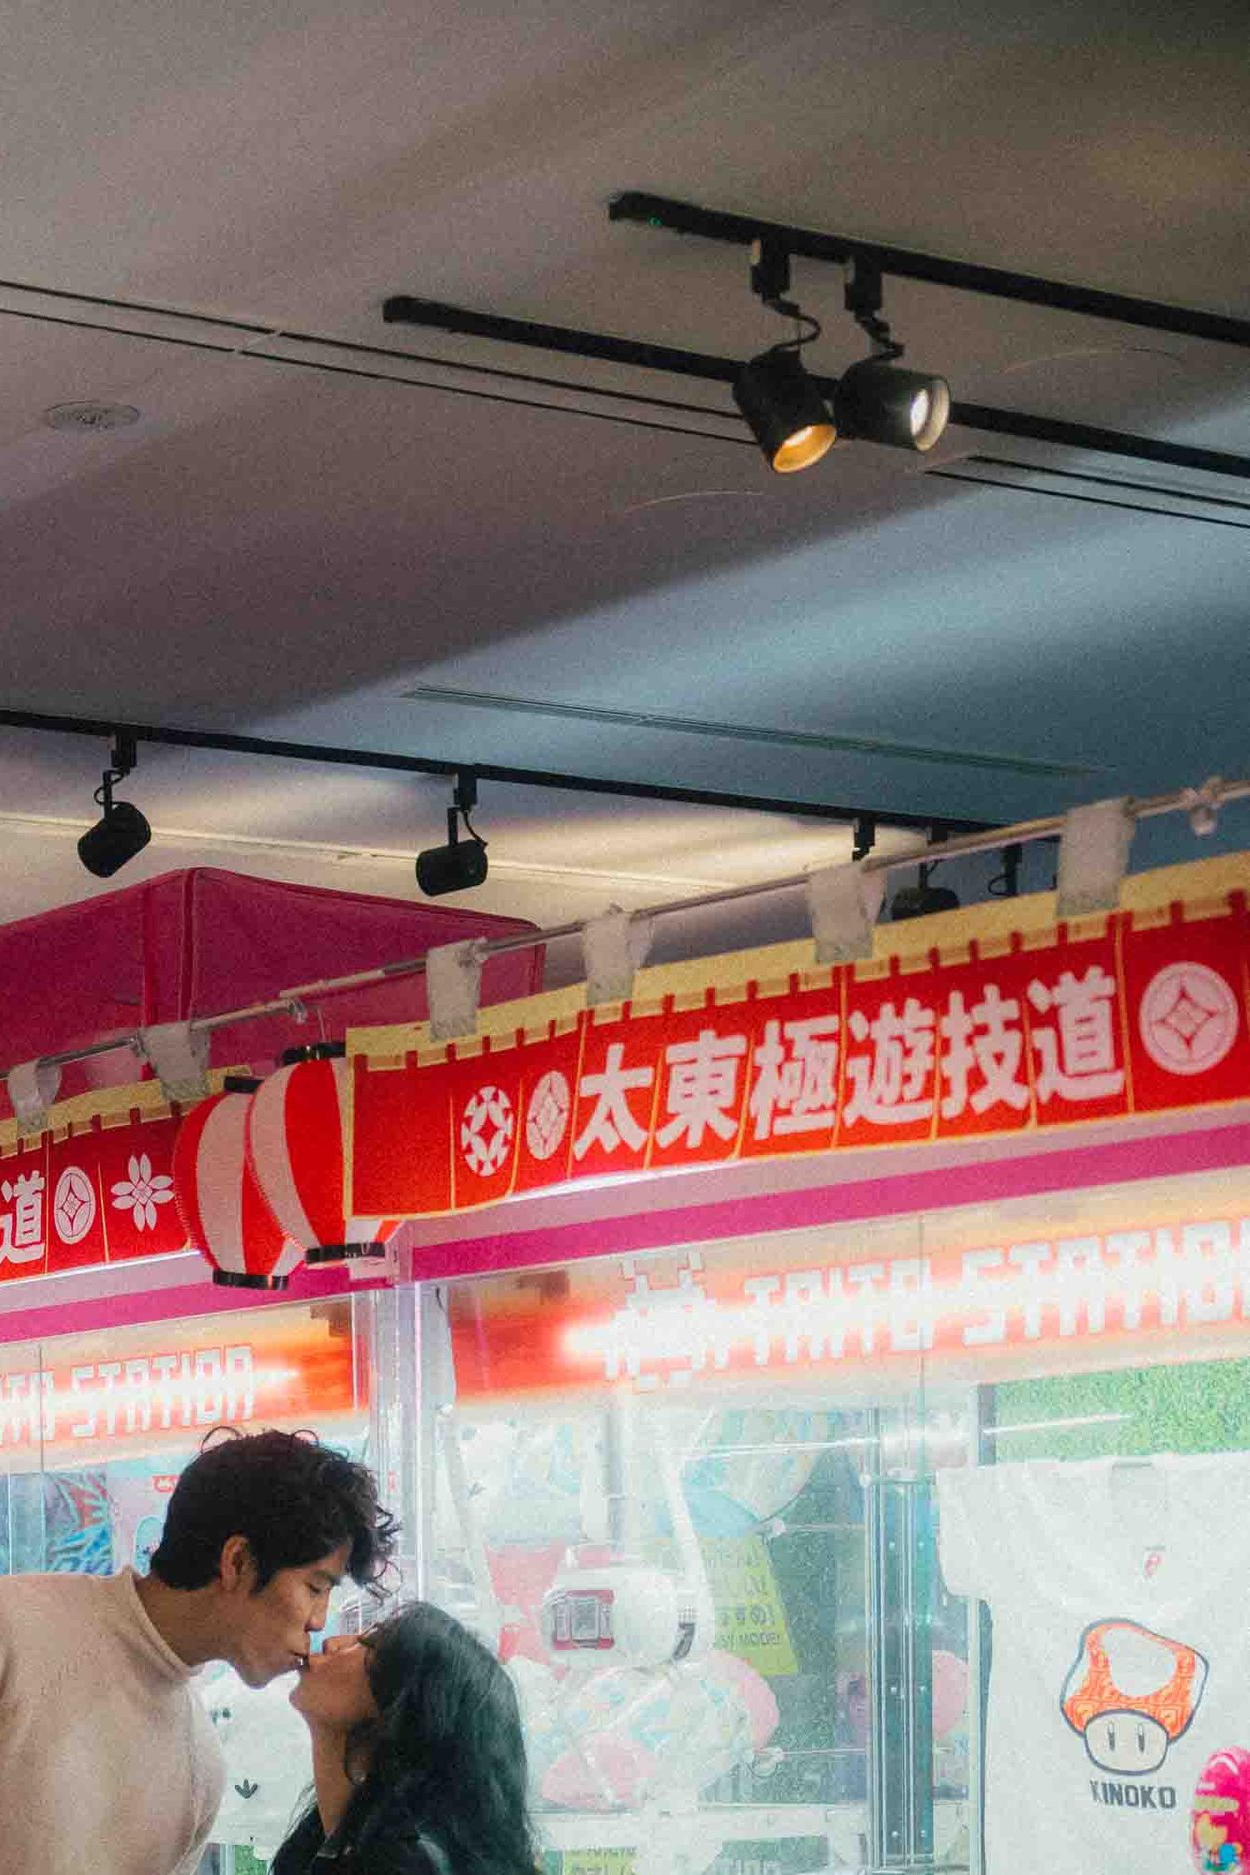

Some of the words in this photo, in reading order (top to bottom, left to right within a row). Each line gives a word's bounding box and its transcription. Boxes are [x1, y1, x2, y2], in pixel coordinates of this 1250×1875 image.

[573, 964, 1125, 1159] 太東極遊技道
[1090, 1780, 1177, 1810] KINOKO
